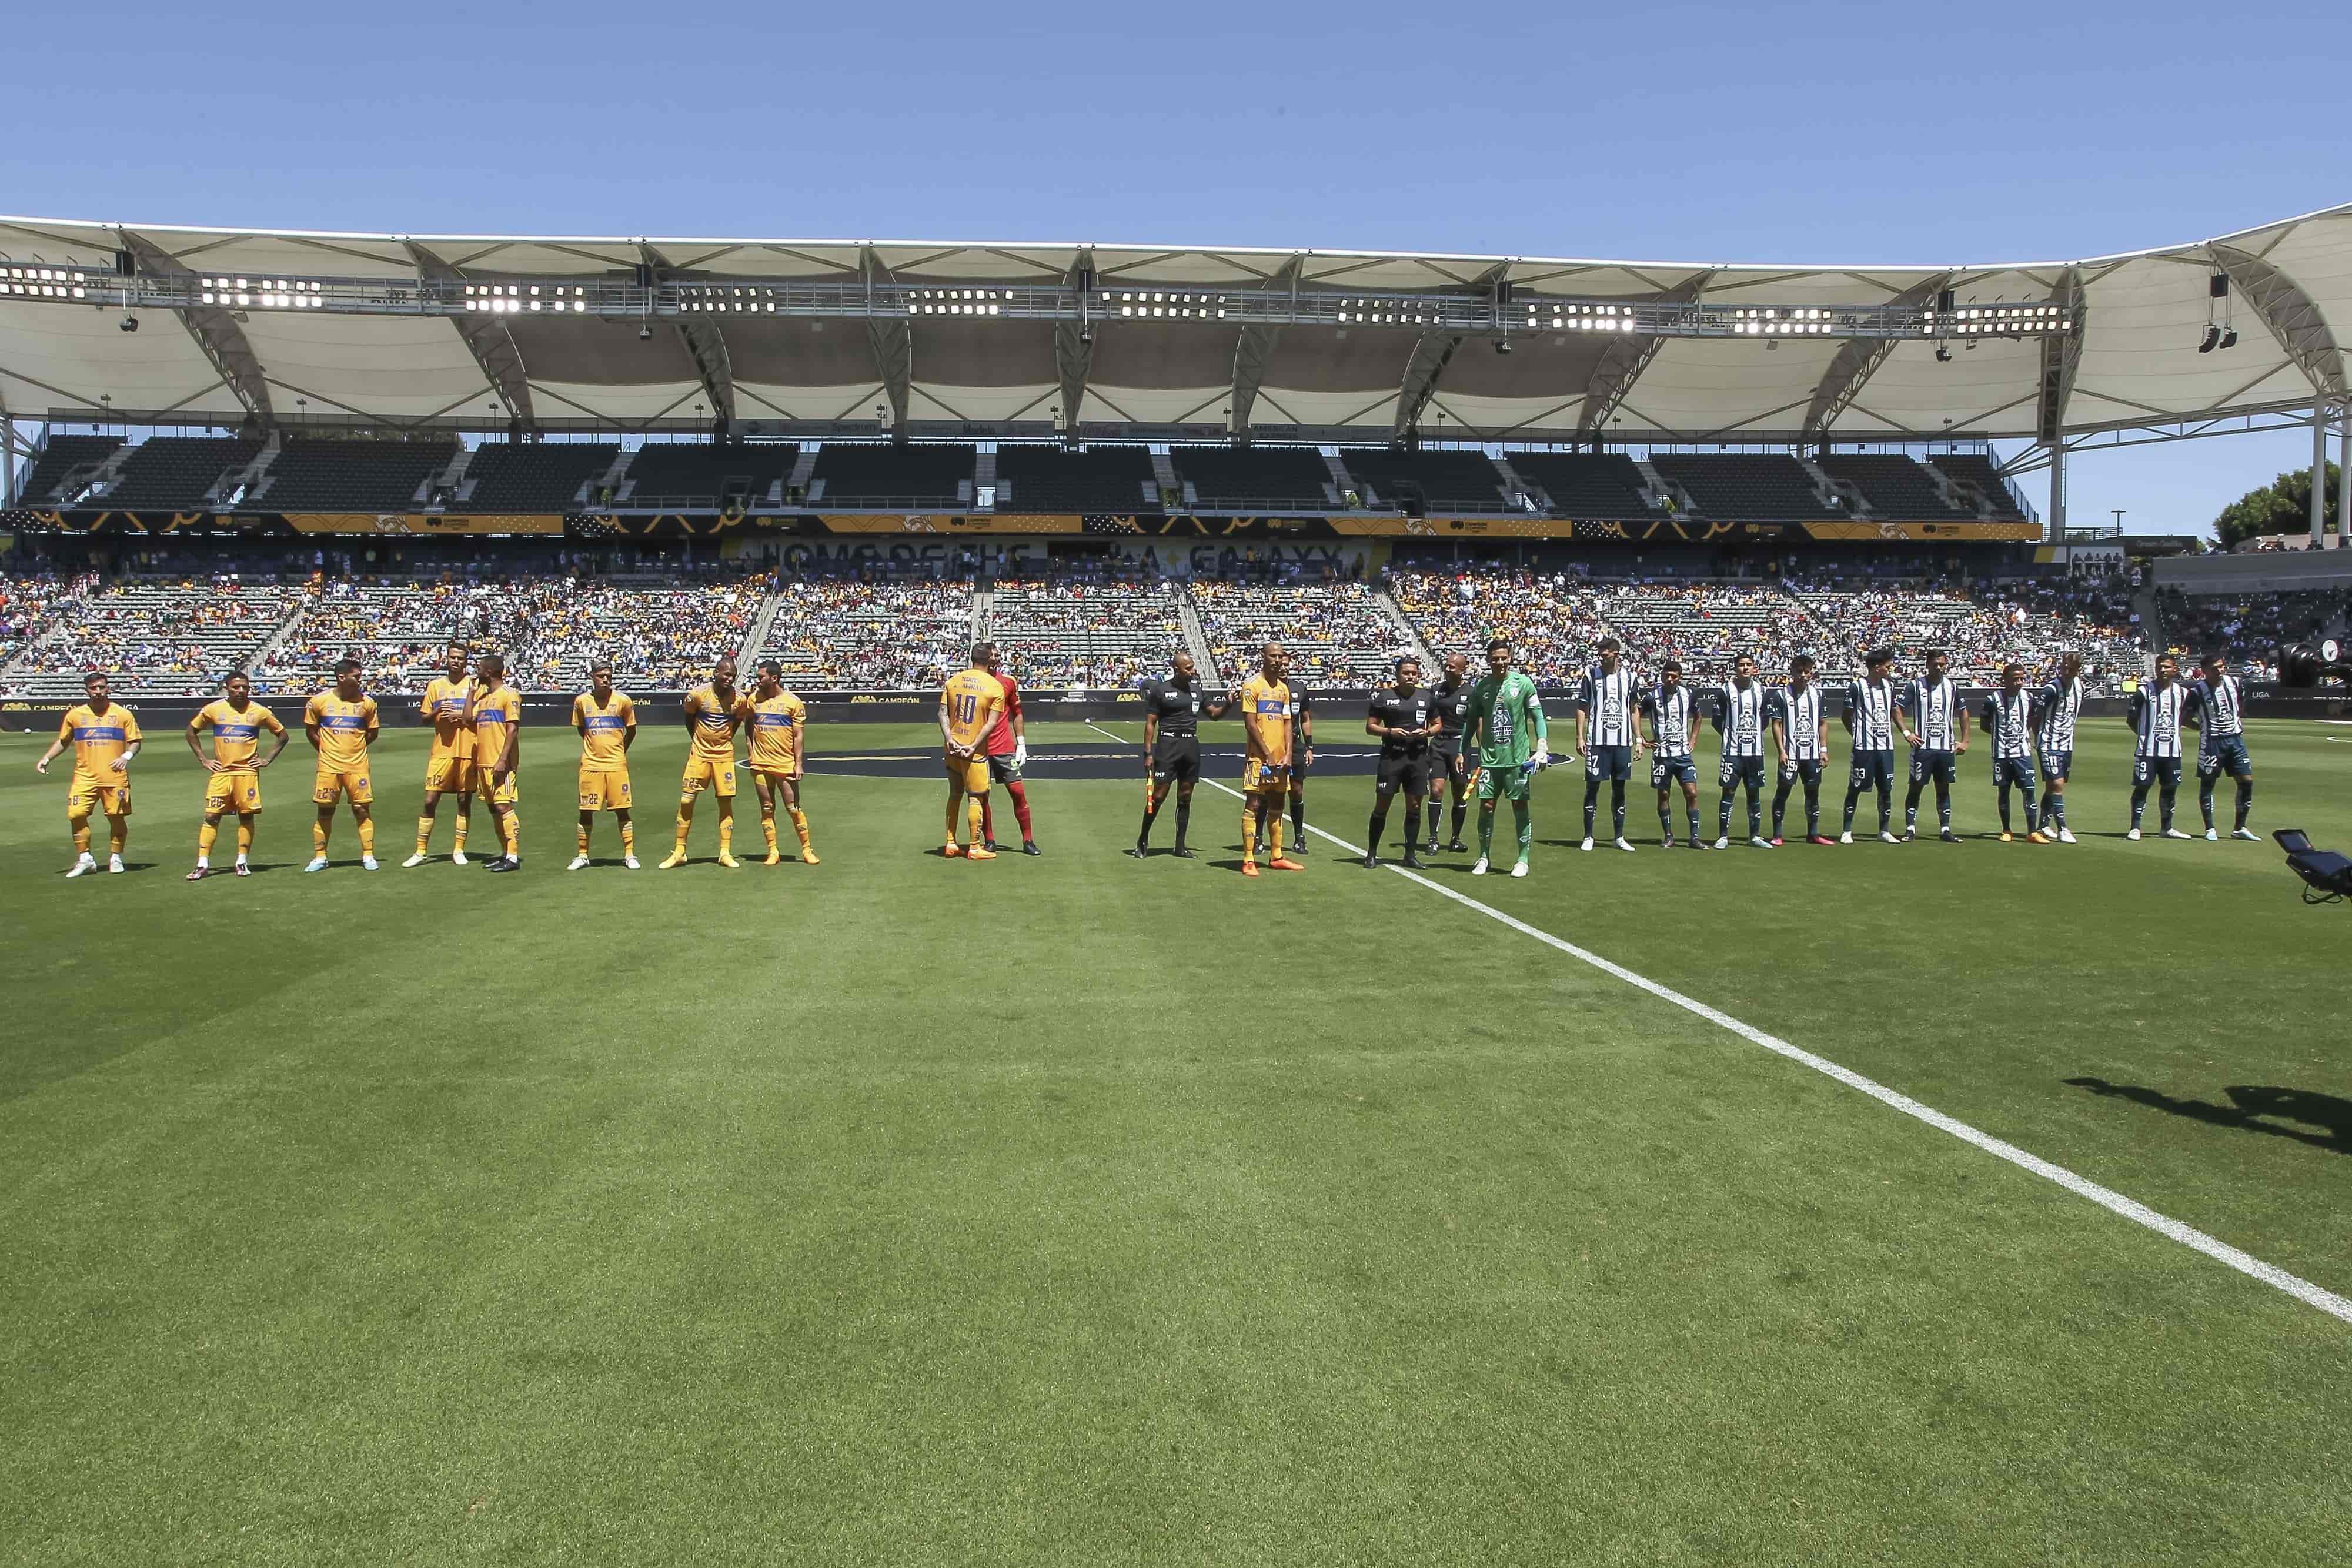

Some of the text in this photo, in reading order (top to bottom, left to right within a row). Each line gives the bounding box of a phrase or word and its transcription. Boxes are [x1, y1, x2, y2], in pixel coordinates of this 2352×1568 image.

[956, 693, 977, 724] 10
[1592, 755, 1598, 767] 7
[1915, 761, 1922, 773] 2
[2049, 755, 2057, 767] 11
[2140, 761, 2147, 773] 9
[2204, 755, 2217, 767] 22
[1653, 764, 1665, 777] 28
[1724, 762, 1733, 774] 15
[1994, 762, 2001, 773] 6
